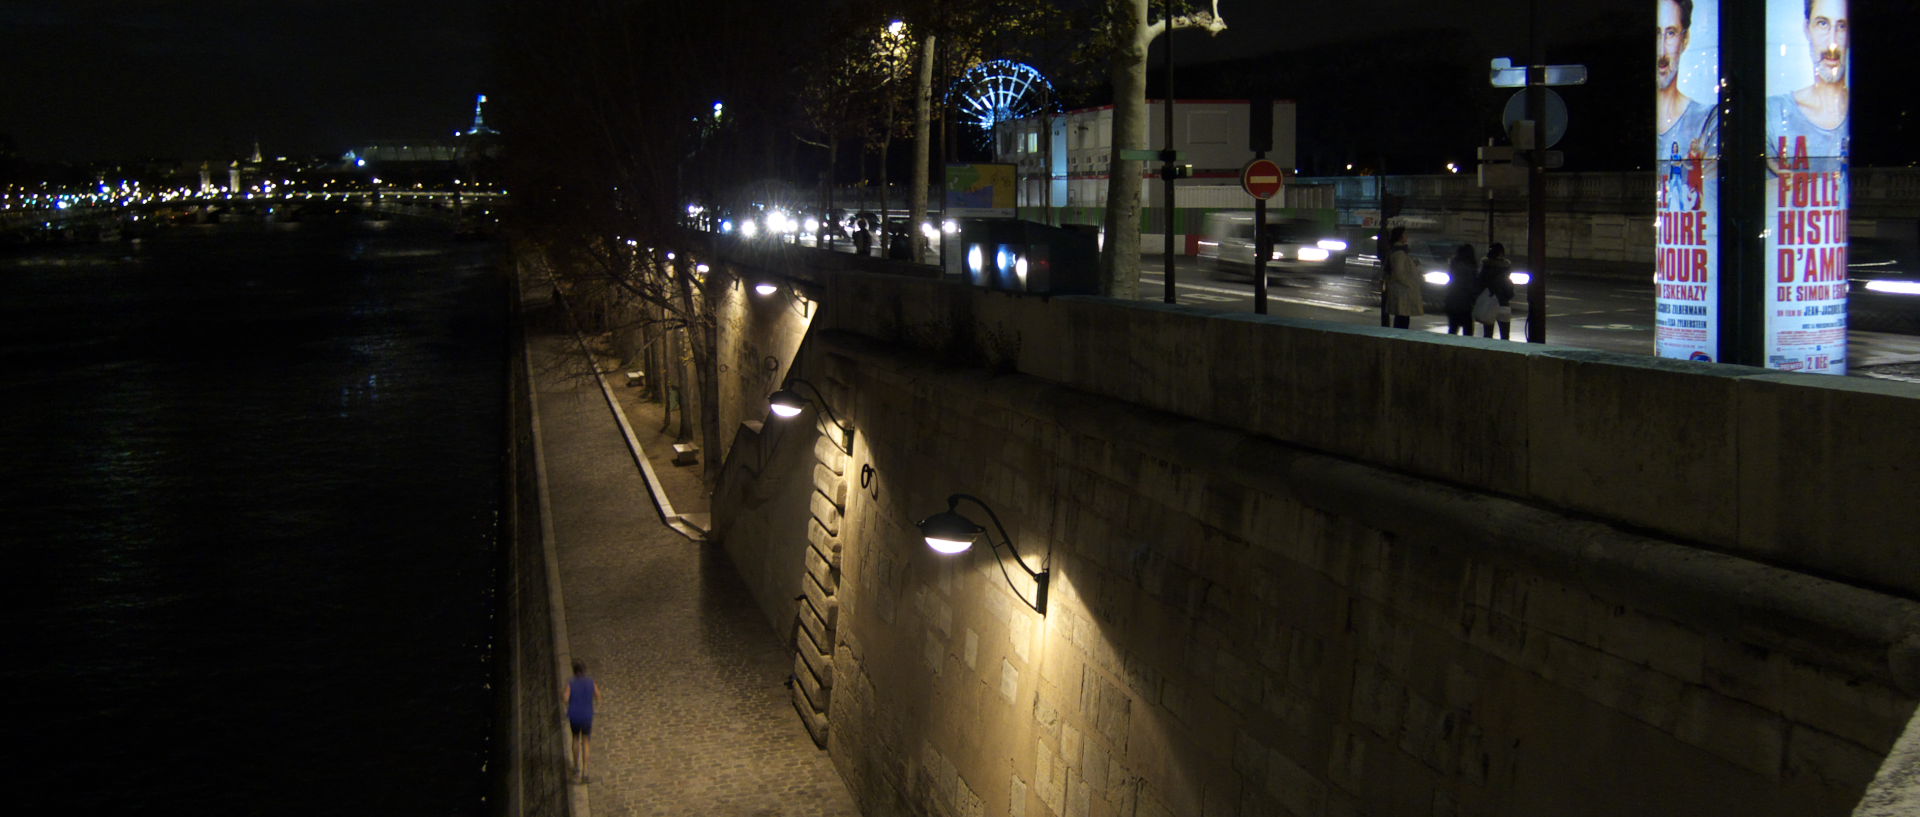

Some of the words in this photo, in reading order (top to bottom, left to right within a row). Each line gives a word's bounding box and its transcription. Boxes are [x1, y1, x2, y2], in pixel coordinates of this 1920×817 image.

[1778, 136, 1809, 170] LA
[1778, 172, 1839, 208] FOLLE
[1663, 284, 1707, 301] ESKENAZY
[1777, 286, 1792, 302] DE
[1796, 285, 1830, 302] SIMON
